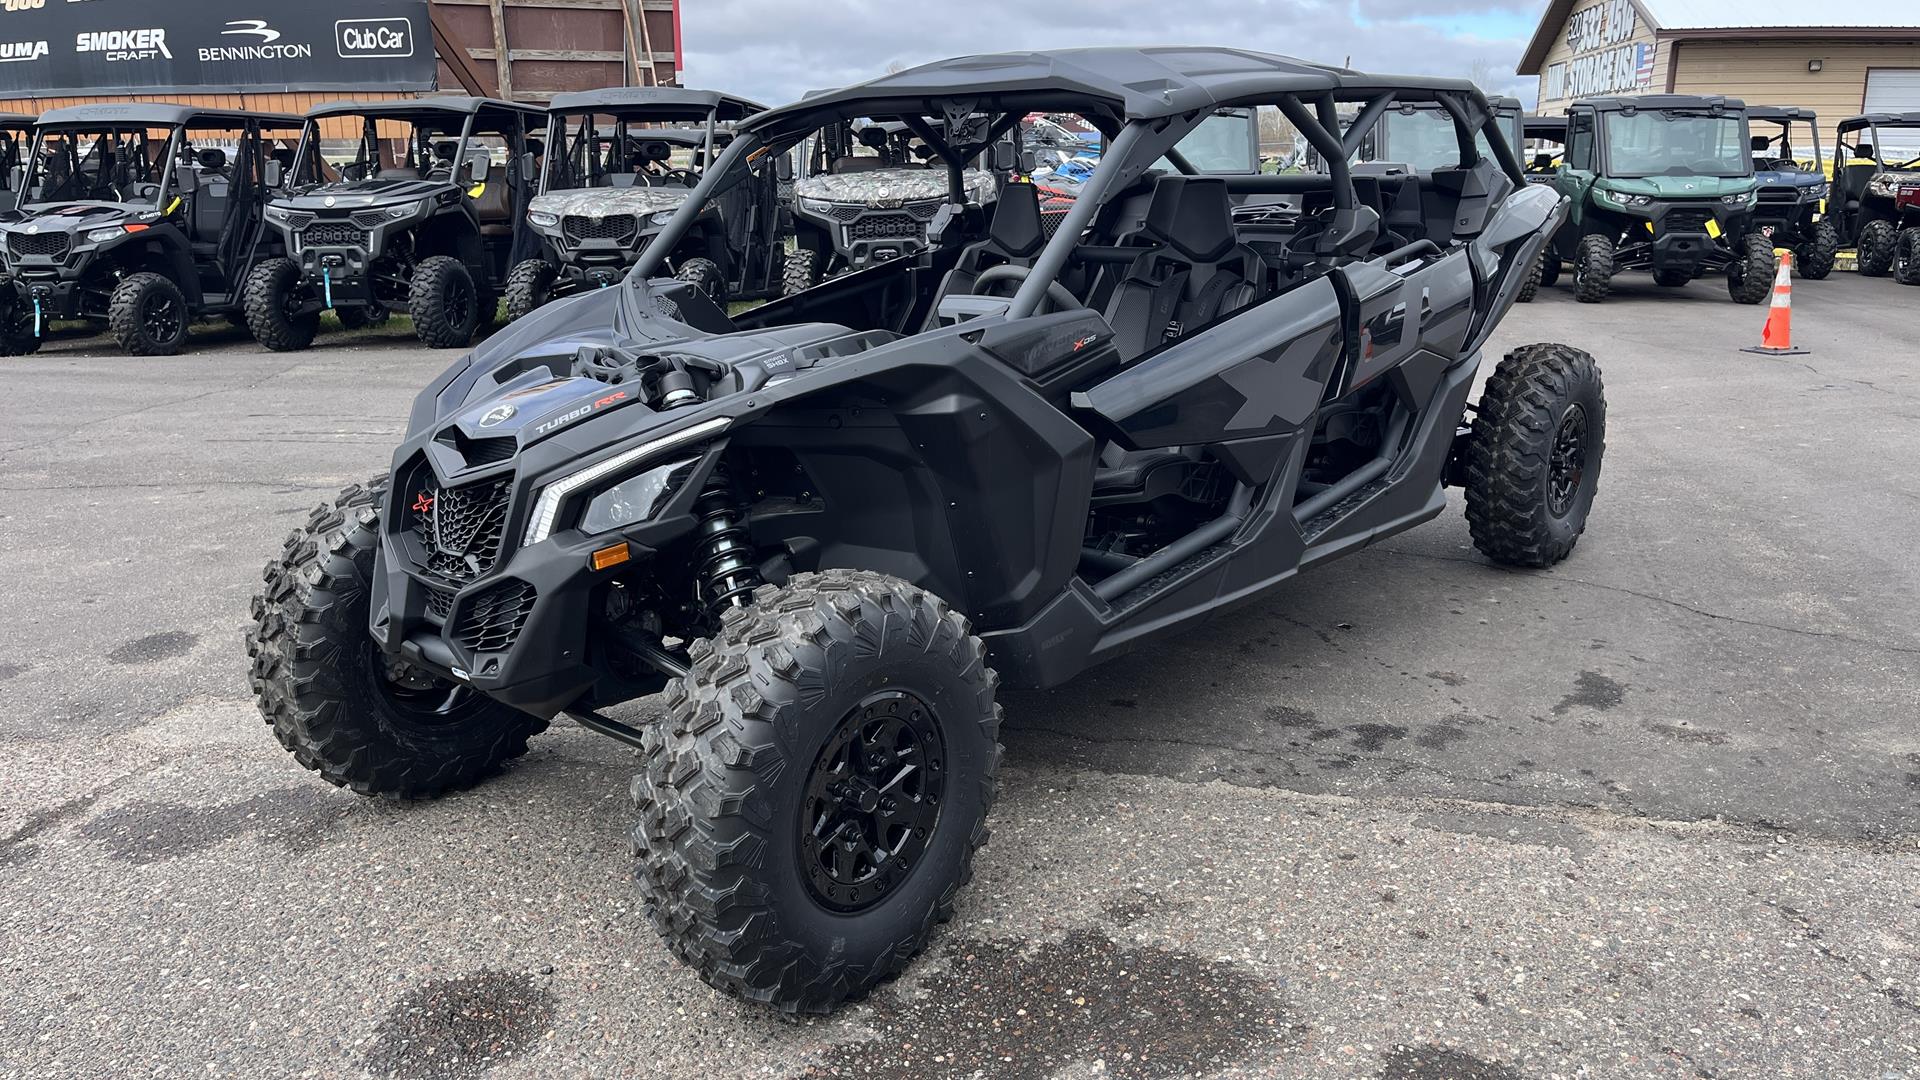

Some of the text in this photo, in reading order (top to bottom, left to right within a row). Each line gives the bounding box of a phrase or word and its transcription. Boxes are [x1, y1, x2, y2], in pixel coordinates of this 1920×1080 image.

[76, 28, 173, 59] SMOKER
[343, 26, 404, 49] Club Car
[106, 50, 159, 61] CRAFT
[198, 39, 312, 61] BENNINGTON
[1568, 49, 1616, 98] STORAGE
[1613, 43, 1638, 90] USA
[306, 231, 361, 242] CFMOTO
[856, 223, 916, 235] CFMOTO
[535, 391, 626, 434] TURBO RR
